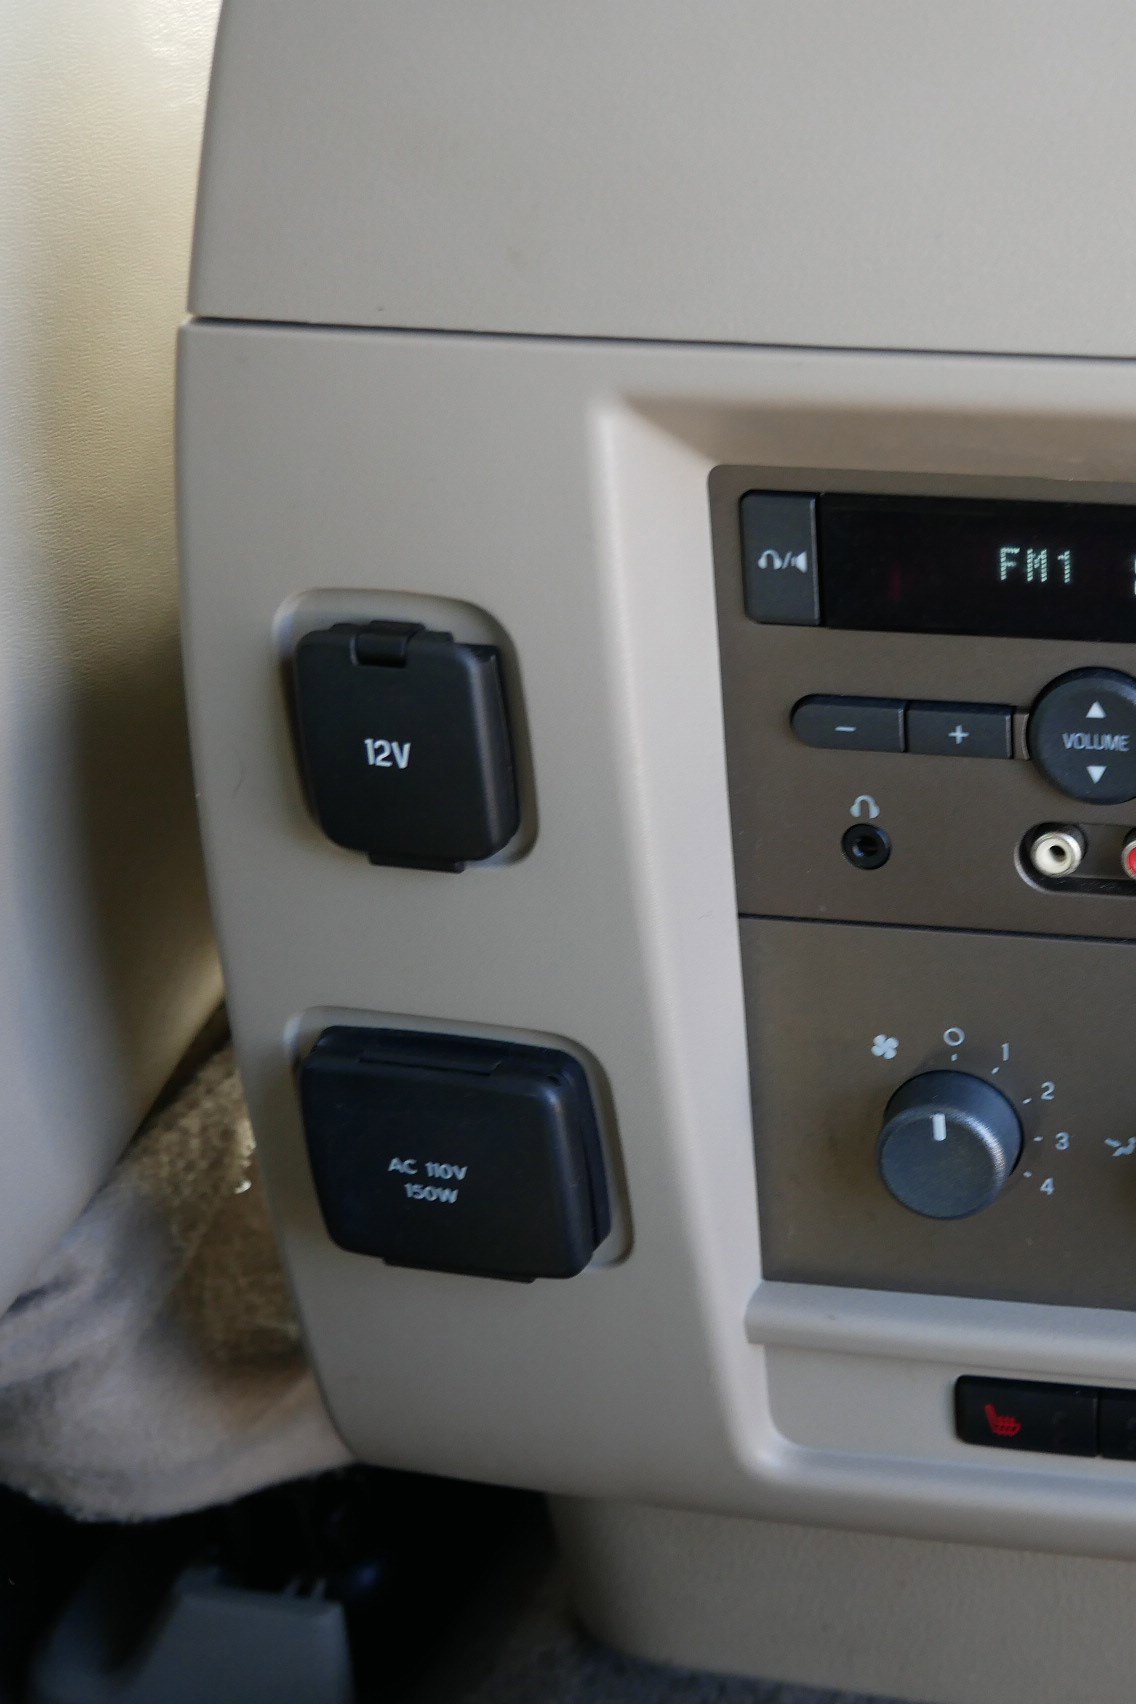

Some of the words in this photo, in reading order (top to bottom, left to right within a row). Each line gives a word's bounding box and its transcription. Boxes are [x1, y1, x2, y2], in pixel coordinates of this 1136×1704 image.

[999, 546, 1073, 585] FM1
[364, 737, 411, 771] 12V
[1062, 731, 1130, 754] VOLUME
[1000, 1042, 1011, 1062] 1
[1040, 1080, 1056, 1101] 2
[1055, 1131, 1070, 1151] 3
[388, 1157, 418, 1176] AC
[425, 1161, 468, 1182] 110V
[404, 1182, 459, 1205] 150W
[1039, 1176, 1055, 1197] 4
